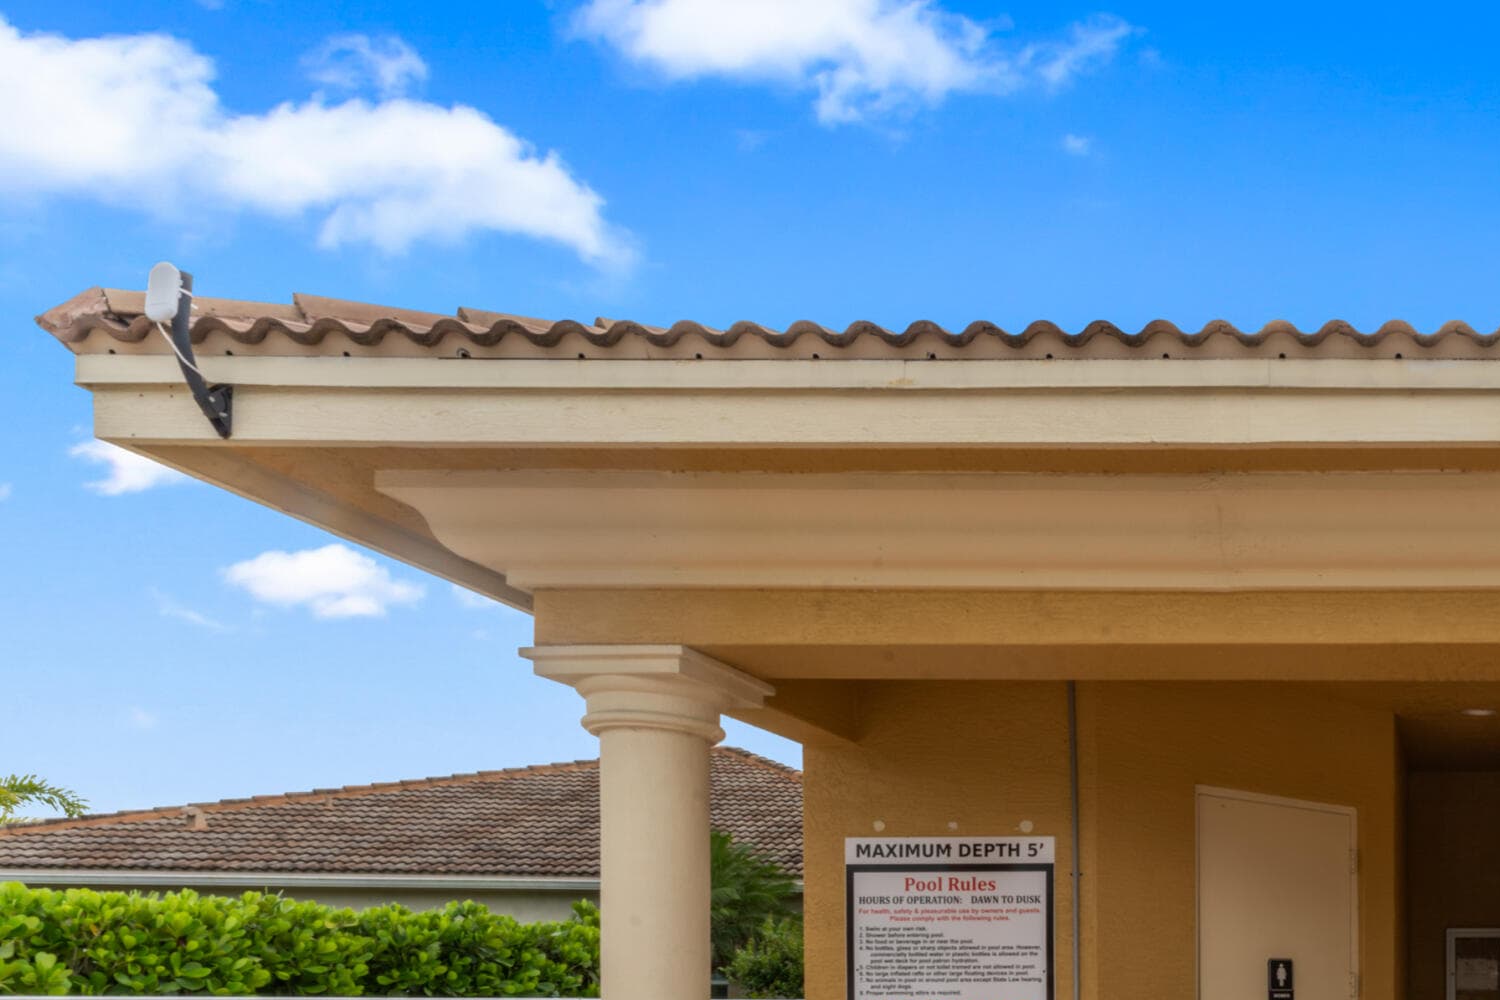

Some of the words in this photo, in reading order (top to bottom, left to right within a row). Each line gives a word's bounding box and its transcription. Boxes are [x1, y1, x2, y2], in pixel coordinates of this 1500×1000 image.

[856, 843, 952, 858] MAXIMUM
[959, 843, 1020, 858] DEPTH
[905, 877, 943, 892] Pool
[948, 877, 996, 892] Rules
[859, 896, 891, 905] HOURS
[892, 896, 905, 905] OF
[906, 896, 962, 905] OPERATION:
[971, 896, 998, 905] DAWN
[1002, 896, 1014, 905] TO
[1016, 896, 1041, 905] DUSK
